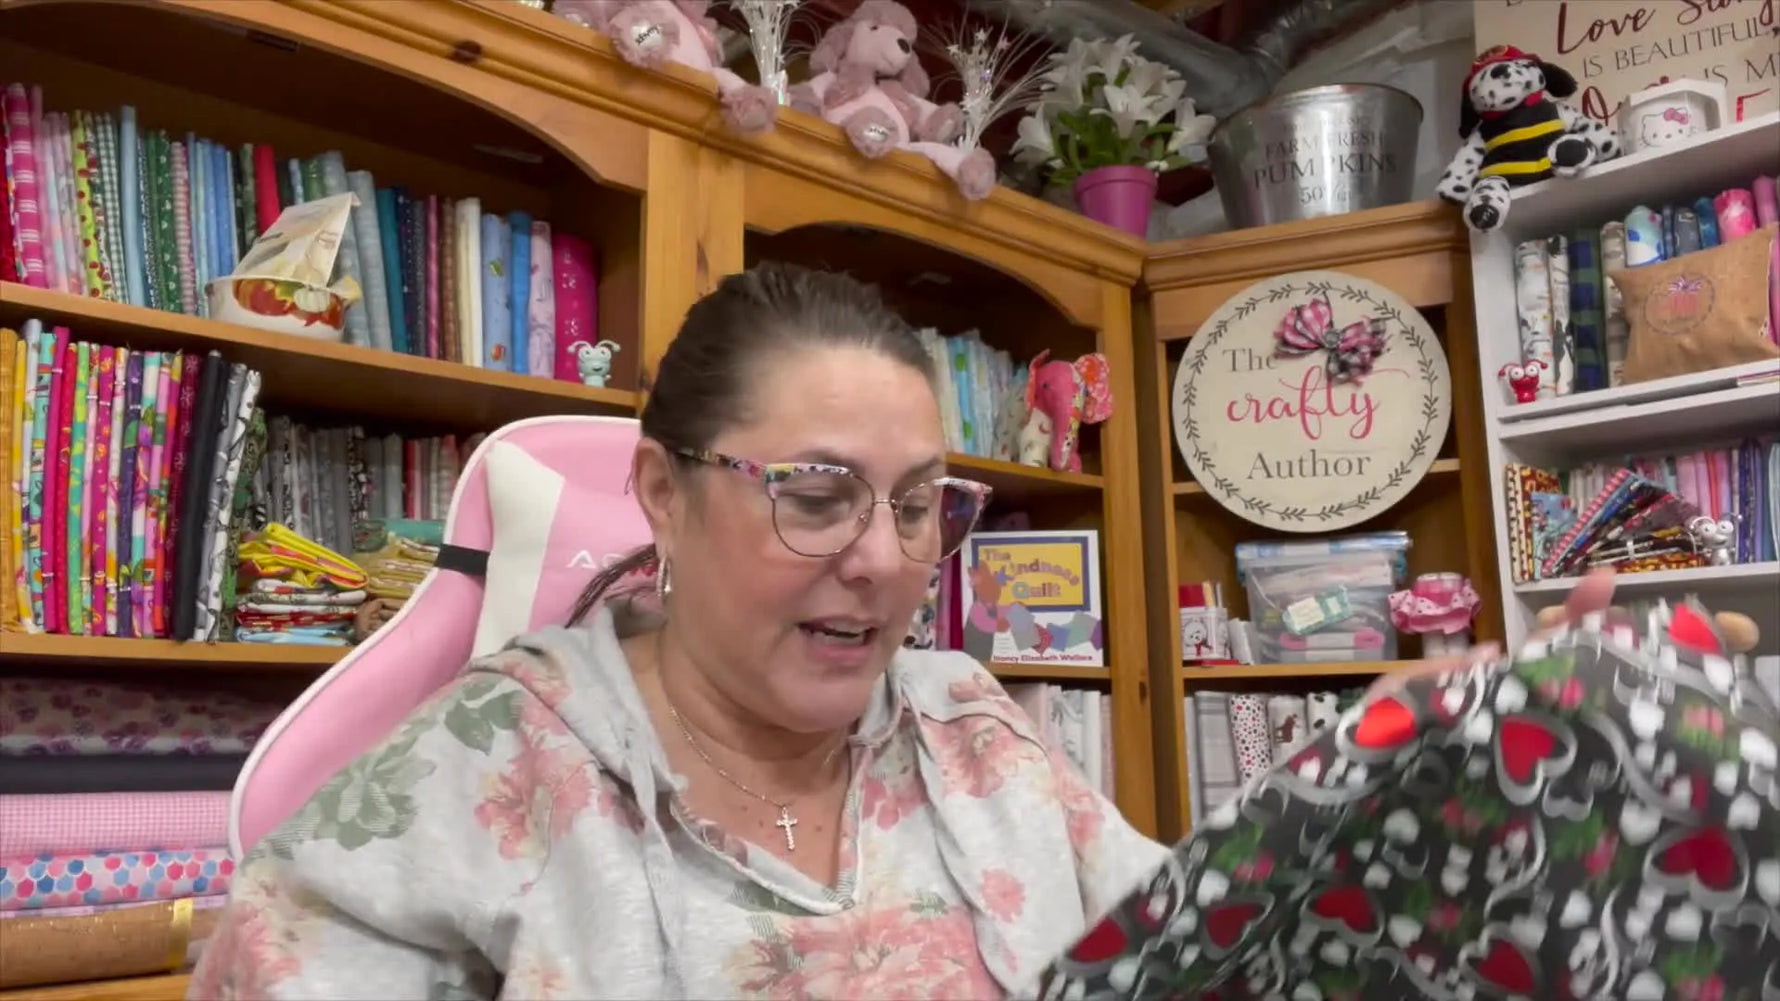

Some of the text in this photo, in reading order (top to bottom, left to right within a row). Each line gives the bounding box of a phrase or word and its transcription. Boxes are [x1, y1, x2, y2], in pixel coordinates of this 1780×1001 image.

[1557, 1, 1656, 54] Love
[1583, 57, 1603, 79] IS
[1222, 347, 1279, 373] The
[1226, 365, 1410, 441] crafty
[1246, 449, 1372, 480] Author
[982, 547, 1011, 561] The
[1012, 581, 1061, 599] Quilt
